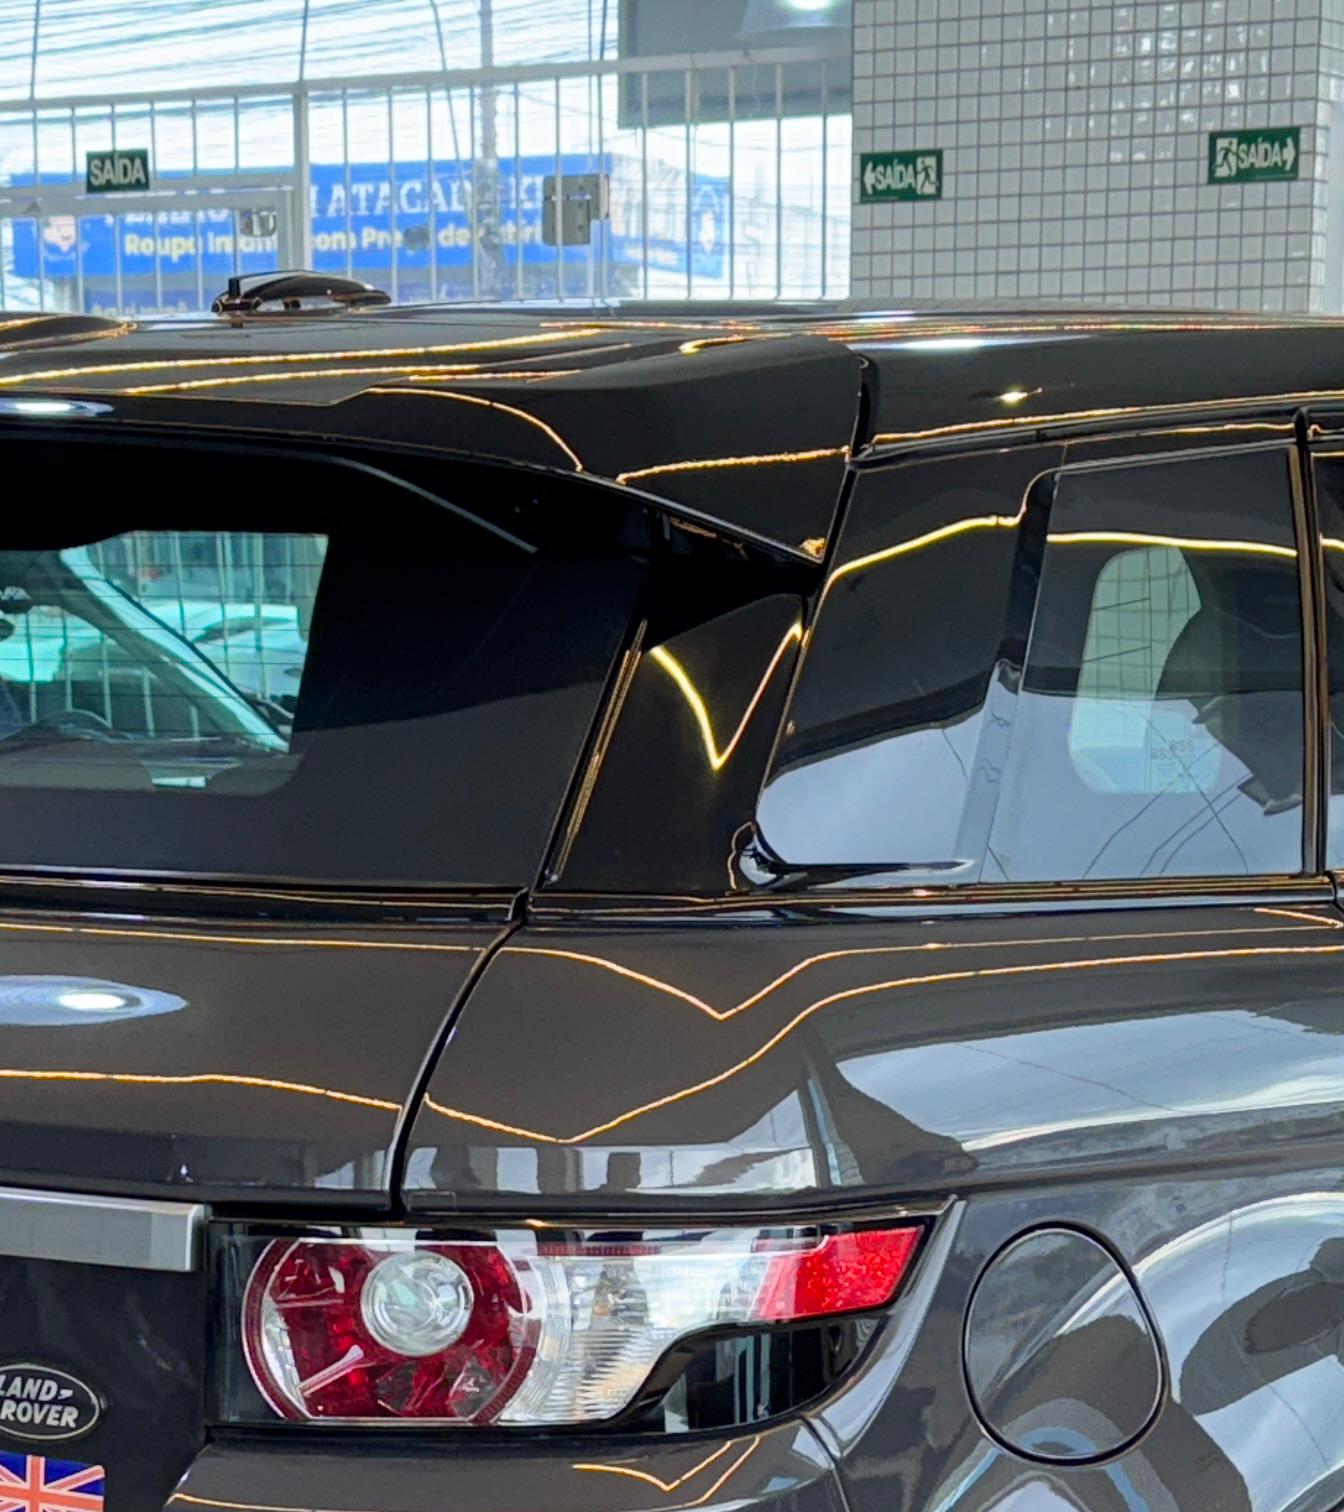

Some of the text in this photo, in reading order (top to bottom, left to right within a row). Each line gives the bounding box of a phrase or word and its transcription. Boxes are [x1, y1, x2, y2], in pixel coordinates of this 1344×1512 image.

[1237, 136, 1282, 168] SAÍDA
[89, 153, 146, 186] SAÍDA
[875, 157, 916, 192] SAÍDA
